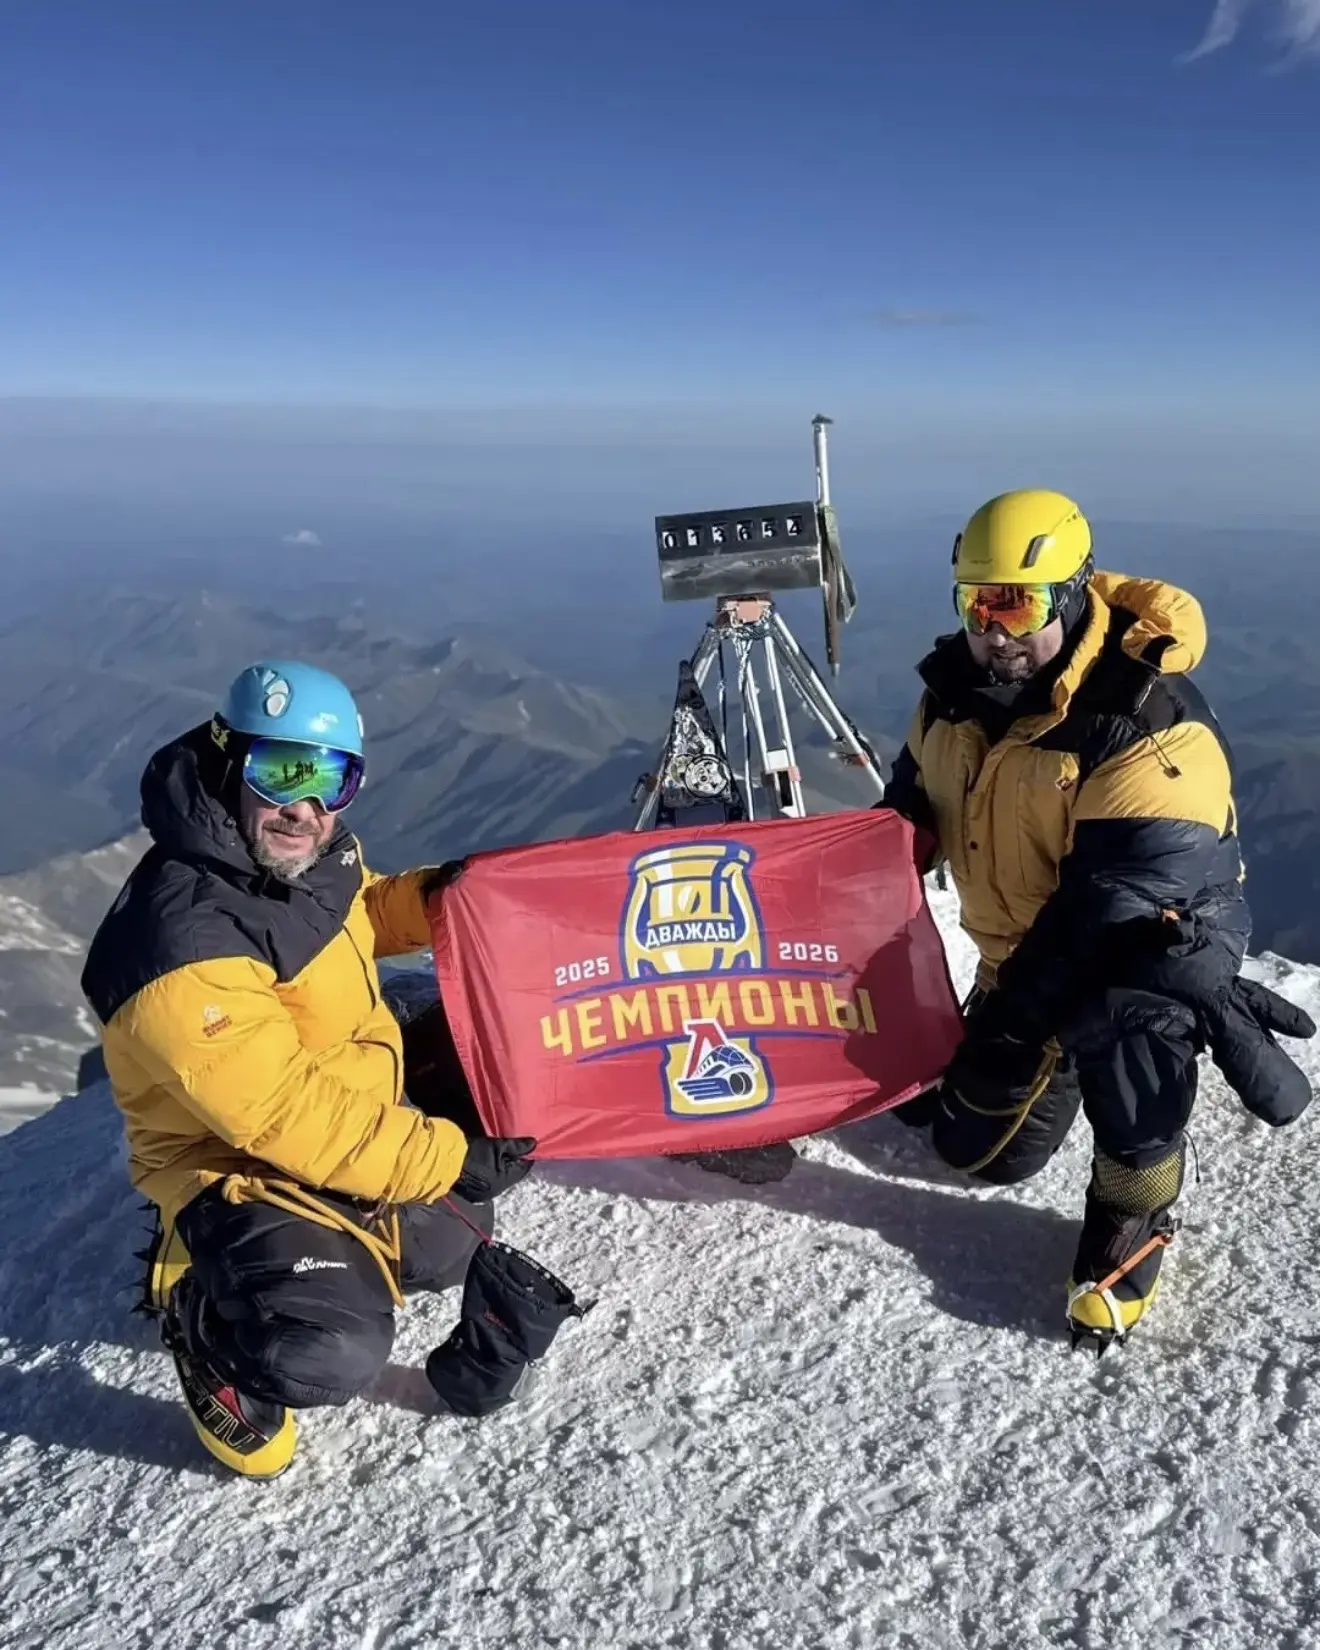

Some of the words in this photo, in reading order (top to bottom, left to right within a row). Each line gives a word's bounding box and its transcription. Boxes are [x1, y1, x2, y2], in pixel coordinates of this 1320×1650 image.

[645, 922, 736, 948] ДВАЖДЫ
[778, 942, 839, 963] 2026
[555, 957, 610, 986] 2025
[540, 980, 878, 1057] ЧЕМПИОНЫ
